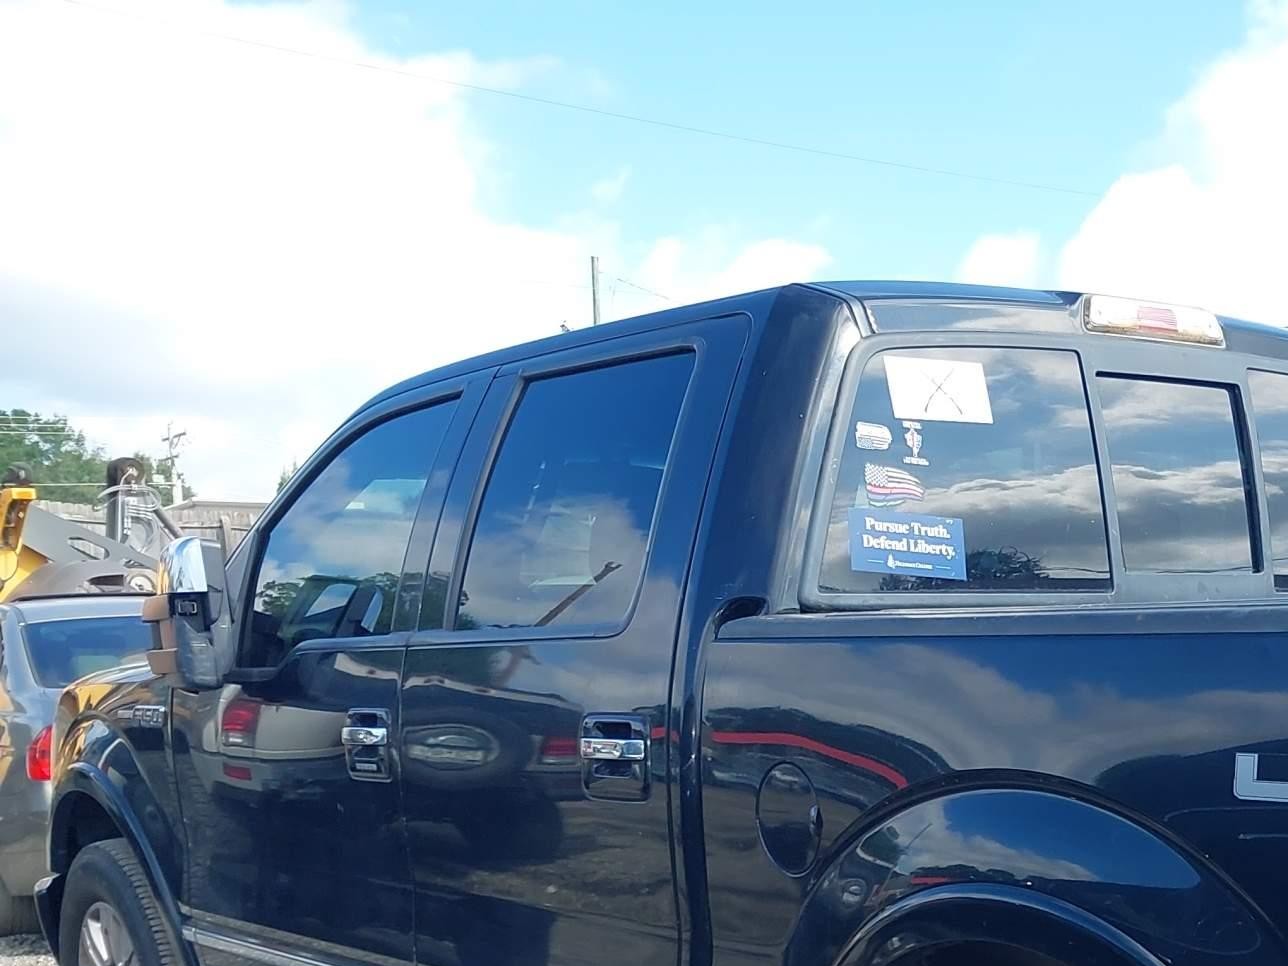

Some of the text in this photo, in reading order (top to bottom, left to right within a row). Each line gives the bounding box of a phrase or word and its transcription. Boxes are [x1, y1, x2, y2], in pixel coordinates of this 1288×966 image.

[864, 516, 951, 539] Pursue Truth.
[862, 534, 956, 560] Defend Liberty.
